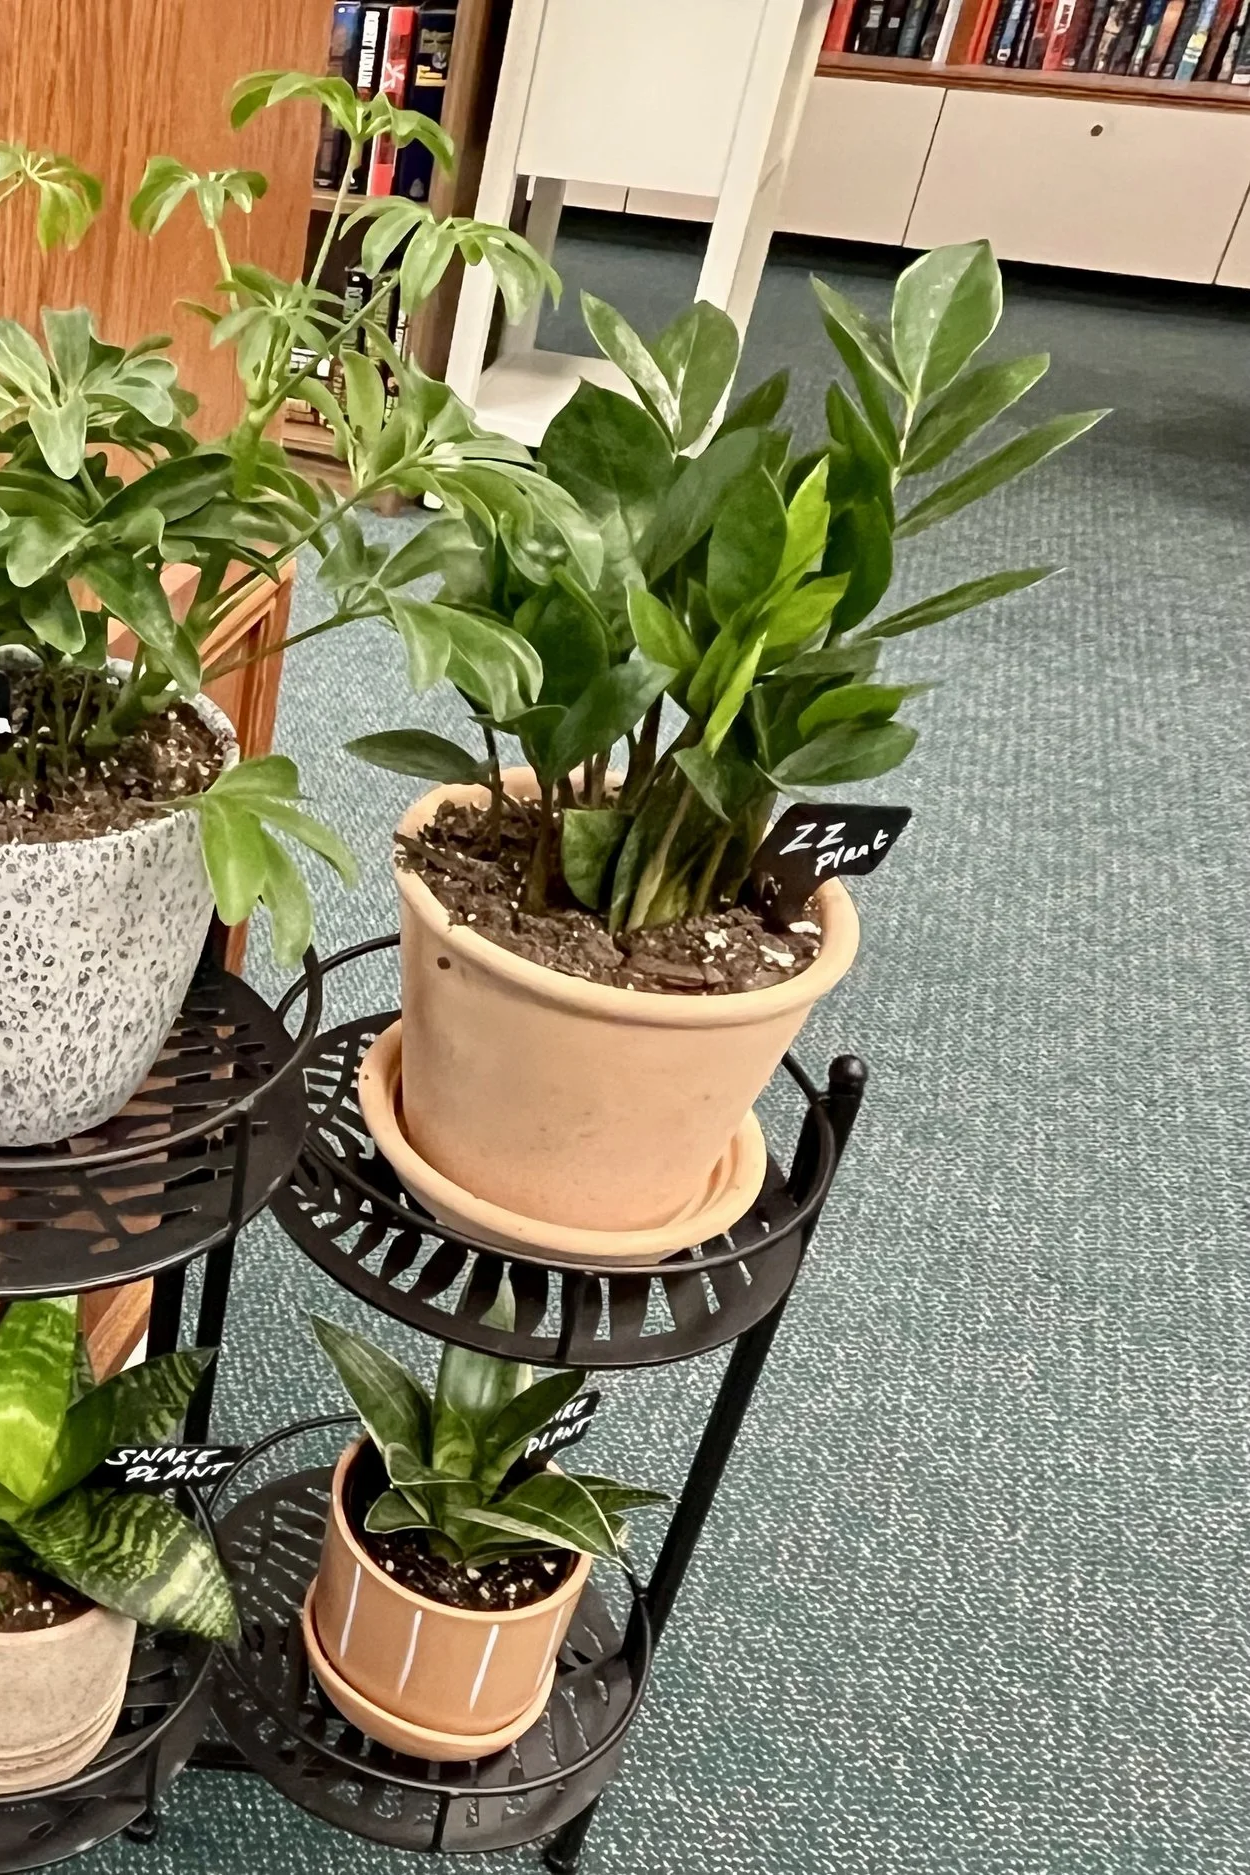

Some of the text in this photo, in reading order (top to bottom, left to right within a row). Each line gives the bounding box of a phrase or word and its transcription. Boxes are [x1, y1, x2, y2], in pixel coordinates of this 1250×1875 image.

[778, 821, 847, 856] ZZ
[814, 828, 890, 877] plant
[523, 1413, 596, 1460] PLANT
[104, 1446, 223, 1466] SNAKE
[124, 1461, 236, 1483] PLANT
